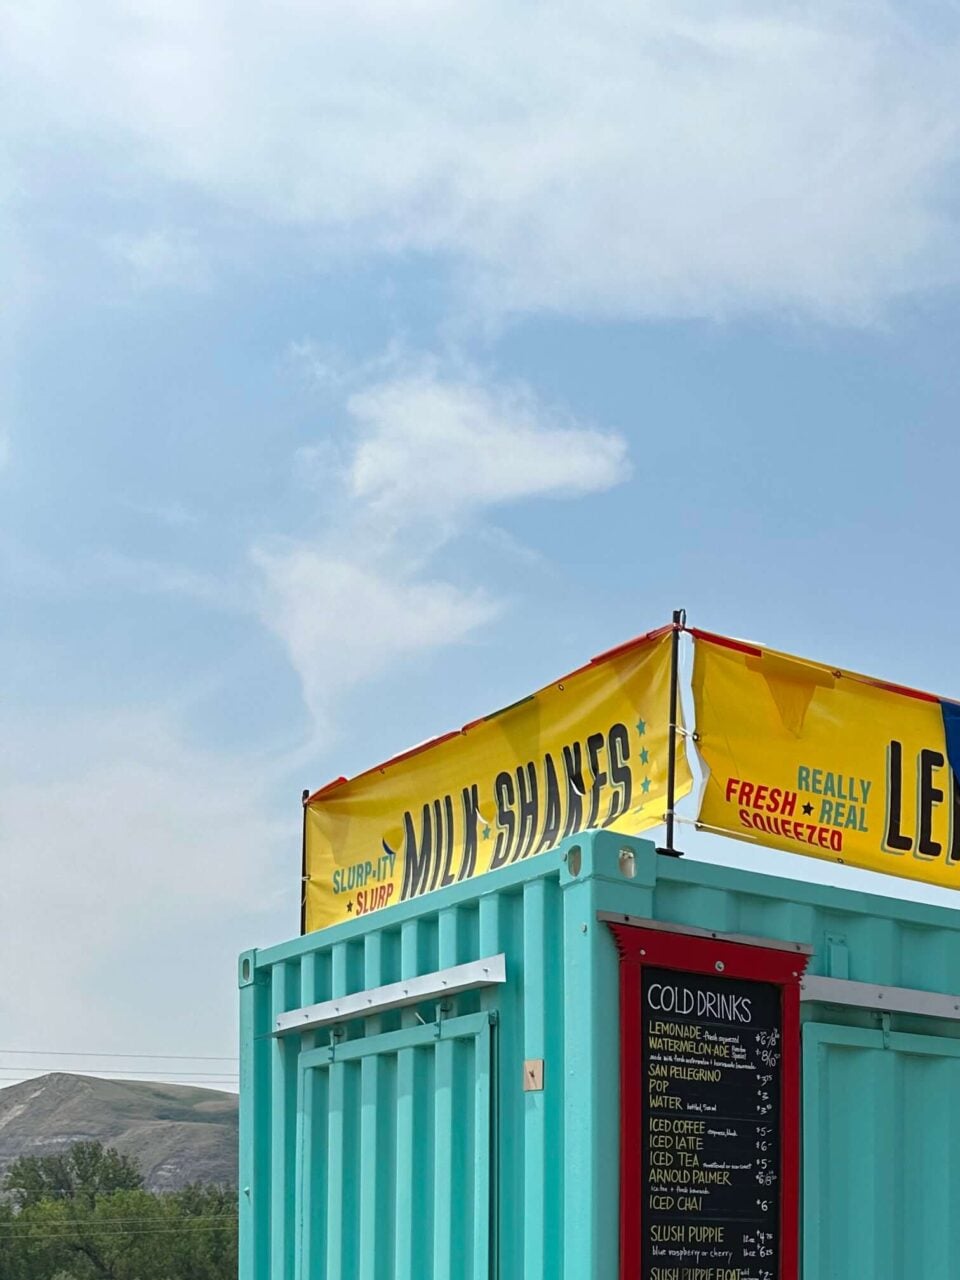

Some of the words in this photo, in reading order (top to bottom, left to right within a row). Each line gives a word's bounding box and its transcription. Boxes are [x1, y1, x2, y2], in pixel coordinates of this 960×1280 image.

[797, 765, 872, 804] REALLY
[725, 777, 797, 816] FRESH
[401, 784, 479, 900] MILK
[488, 723, 632, 870] SHAKES
[818, 798, 869, 832] REAL
[738, 809, 843, 852] SQUEEZED
[333, 854, 396, 895] SLURP-ITY
[355, 883, 394, 916] SLURP
[647, 983, 695, 1015] COLD
[697, 990, 752, 1023] DRINKS
[649, 1020, 702, 1039] LEMONADE
[649, 1036, 730, 1058] WATERMELON-ADE
[648, 1063, 668, 1078] SAN
[669, 1065, 721, 1082] PELLEGRINO
[649, 1079, 669, 1093] POP
[649, 1094, 683, 1110] WATER
[649, 1117, 672, 1133] ICED
[673, 1119, 706, 1134] COFFEE
[649, 1135, 674, 1149] ICED
[675, 1136, 704, 1150] LATTE
[649, 1151, 674, 1166] ICED
[677, 1151, 700, 1167] TEA
[649, 1168, 690, 1184] ARNOLD
[692, 1170, 732, 1186] PALMER
[649, 1194, 674, 1210] ICED
[677, 1196, 702, 1211] CHAI
[650, 1225, 685, 1242] SLUSH
[688, 1226, 725, 1243] PUPPIE
